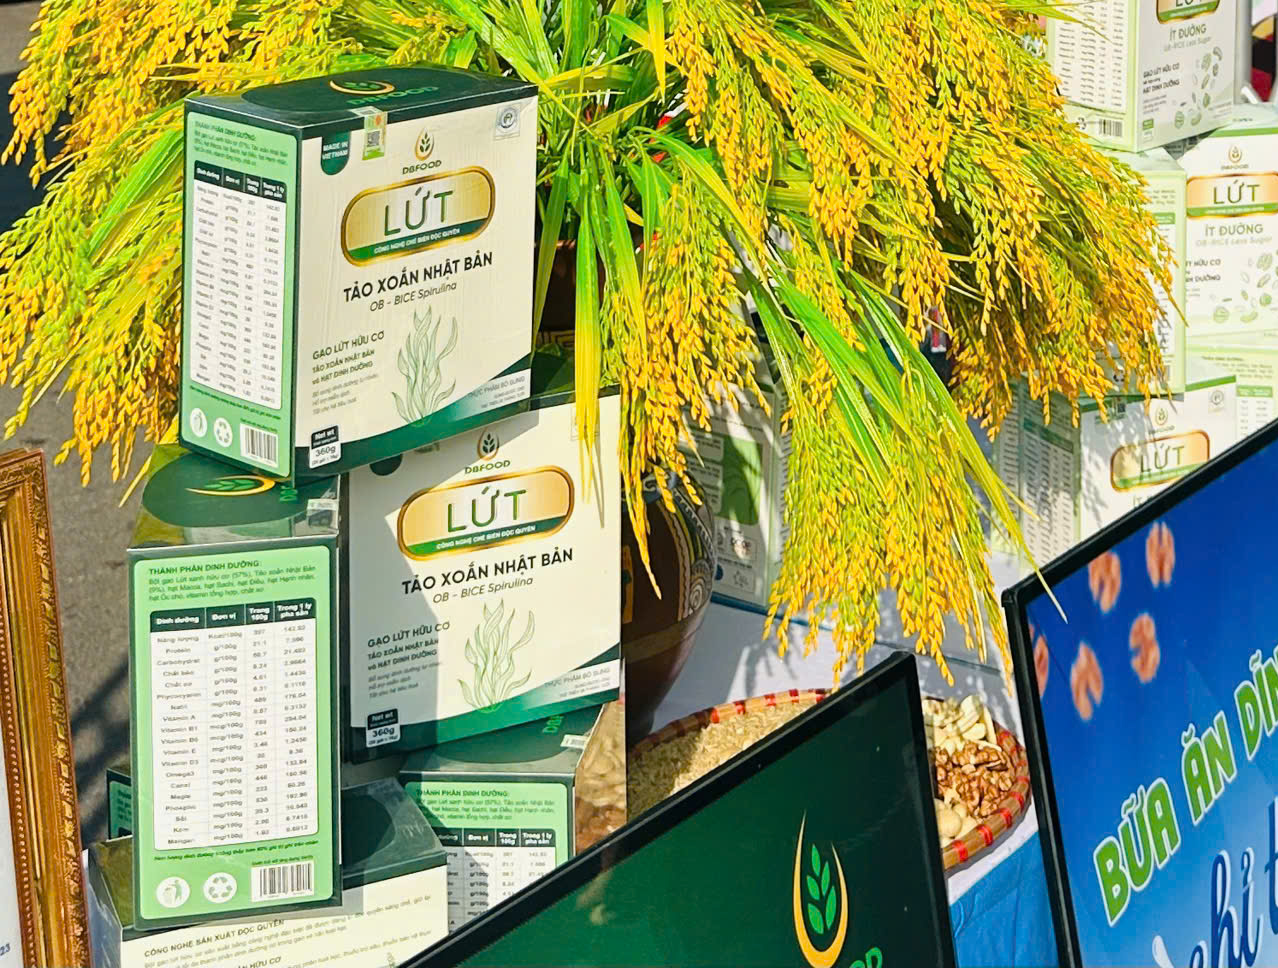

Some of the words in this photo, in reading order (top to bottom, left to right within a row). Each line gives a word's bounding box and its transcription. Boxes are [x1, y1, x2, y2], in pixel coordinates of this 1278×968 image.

[1169, 28, 1178, 41] ÍT
[322, 149, 349, 160] VIETNAM
[323, 143, 341, 152] MADE
[402, 160, 442, 175] DBFOOD
[1213, 180, 1260, 204] LỨT
[384, 186, 454, 236] LỨT
[1205, 224, 1216, 237] ÍT
[1218, 223, 1264, 236] ĐƯỜNG
[344, 281, 373, 303] TẢO
[378, 266, 419, 294] XOẮN
[423, 259, 460, 281] NHẬT
[464, 250, 493, 272] BẢN
[370, 300, 384, 312] OB
[417, 281, 457, 301] Spirulina
[334, 340, 350, 354] LỨT
[351, 335, 369, 349] HỮU
[371, 330, 385, 343] CƠ
[334, 367, 349, 377] DINH
[315, 446, 336, 457] 360g
[1140, 443, 1185, 473] LỨT
[464, 460, 511, 474] DBFOOD
[447, 484, 527, 533] LỨT
[402, 574, 436, 595] TẢO
[441, 560, 489, 587] XOẮN
[494, 554, 538, 576] NHẬT
[541, 546, 574, 567] BẢN
[432, 592, 450, 604] OB
[487, 576, 534, 596] Spirulina
[393, 630, 410, 641] LỨT
[412, 625, 432, 637] HỮU
[435, 621, 450, 632] CƠ
[372, 727, 395, 738] 360g
[1094, 778, 1181, 926] BỮA
[1181, 710, 1237, 826] ĂN
[144, 949, 169, 957] CÔNG
